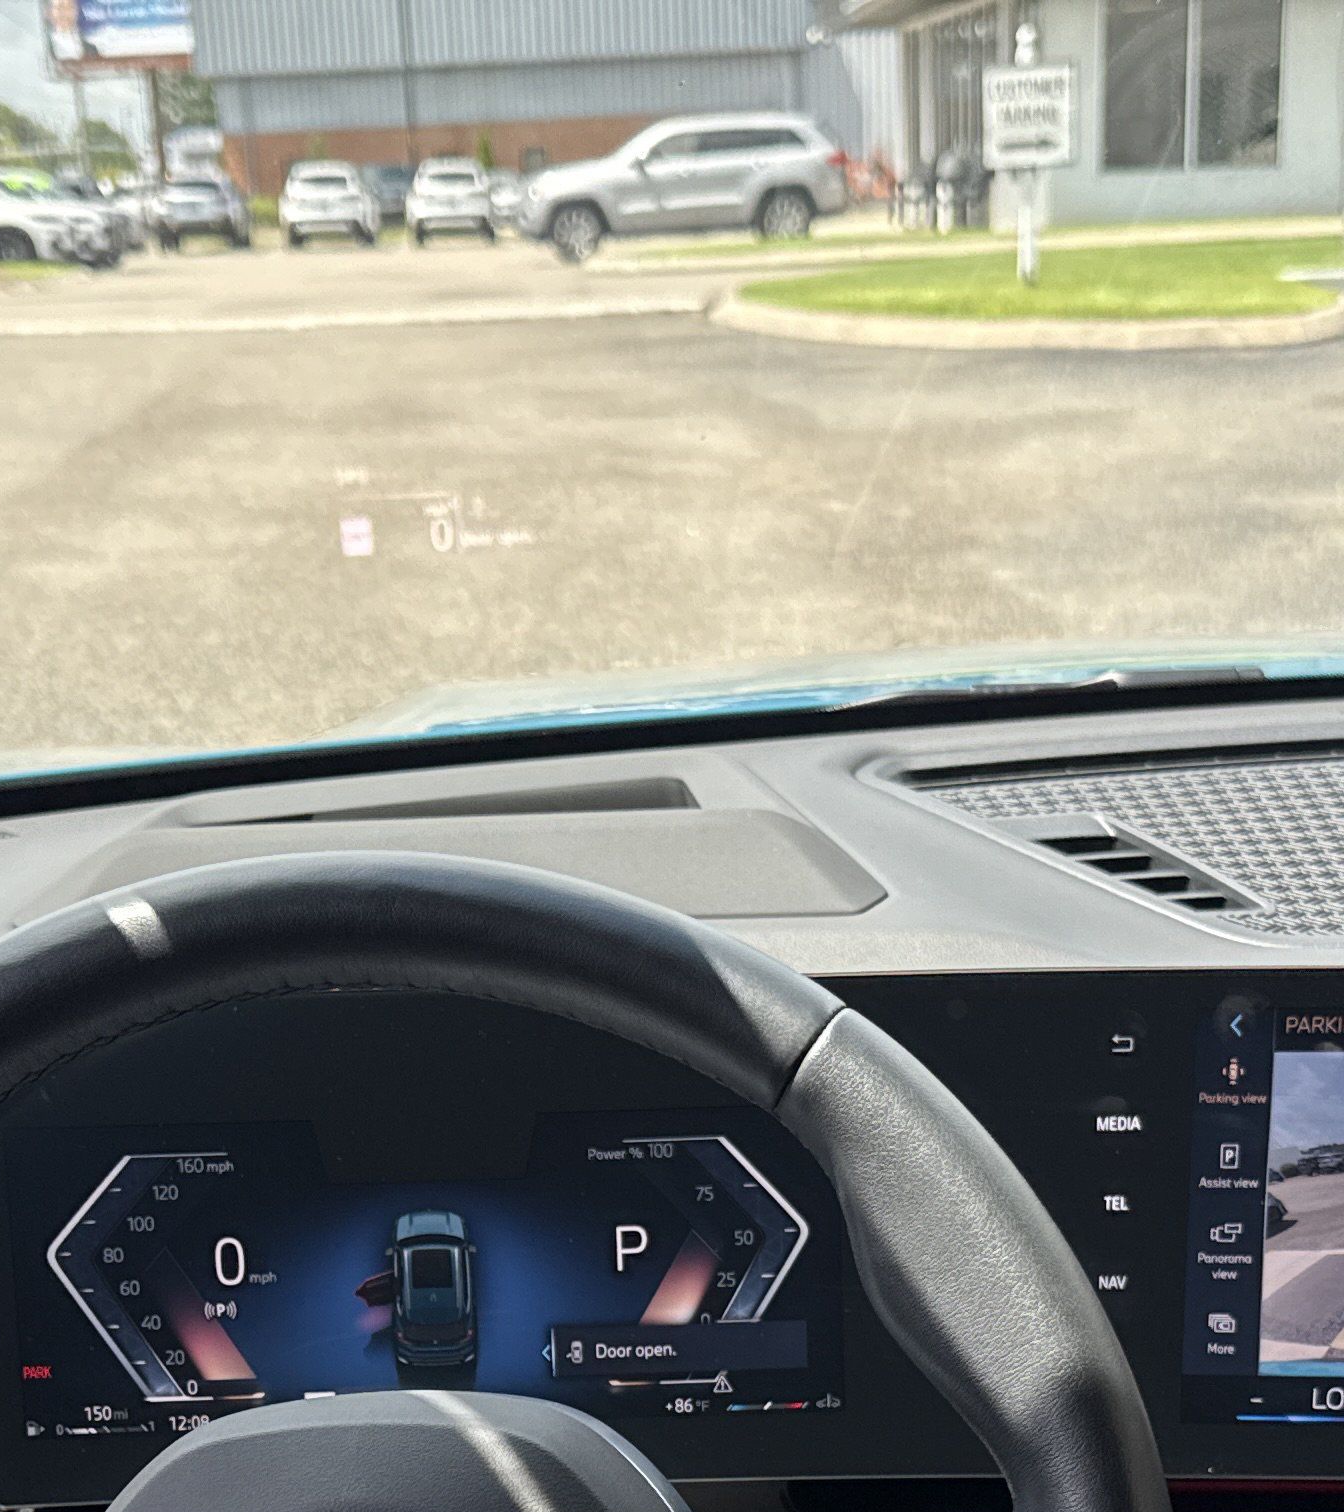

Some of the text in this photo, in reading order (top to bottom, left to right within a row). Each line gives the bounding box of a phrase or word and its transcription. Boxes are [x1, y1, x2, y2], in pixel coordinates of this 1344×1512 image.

[1198, 1092, 1268, 1106] Parking view
[1096, 1115, 1142, 1131] MEDIA
[588, 1143, 673, 1160] Power % 100
[176, 1158, 234, 1175] 160 mph
[1198, 1177, 1258, 1189] Assist view
[152, 1185, 179, 1200] 120
[696, 1186, 714, 1202] 75
[1104, 1195, 1129, 1211] TEL
[127, 1216, 155, 1232] 100
[734, 1230, 754, 1246] 50
[103, 1247, 124, 1263] 80
[616, 1225, 648, 1272] P
[215, 1237, 277, 1286] 0 mph
[1197, 1252, 1253, 1265] Panorama
[717, 1272, 736, 1288] 25
[1212, 1269, 1238, 1280] view
[120, 1280, 140, 1296] 60
[1099, 1276, 1127, 1290] NAV
[141, 1315, 161, 1331] 40
[595, 1344, 677, 1360] Door open.
[1207, 1343, 1235, 1354] More
[165, 1350, 185, 1366] 20
[23, 1365, 53, 1380] PARK
[187, 1379, 198, 1395] 0
[666, 1397, 693, 1413] +86
[84, 1406, 128, 1422] 150 mi
[56, 1424, 64, 1436] 0
